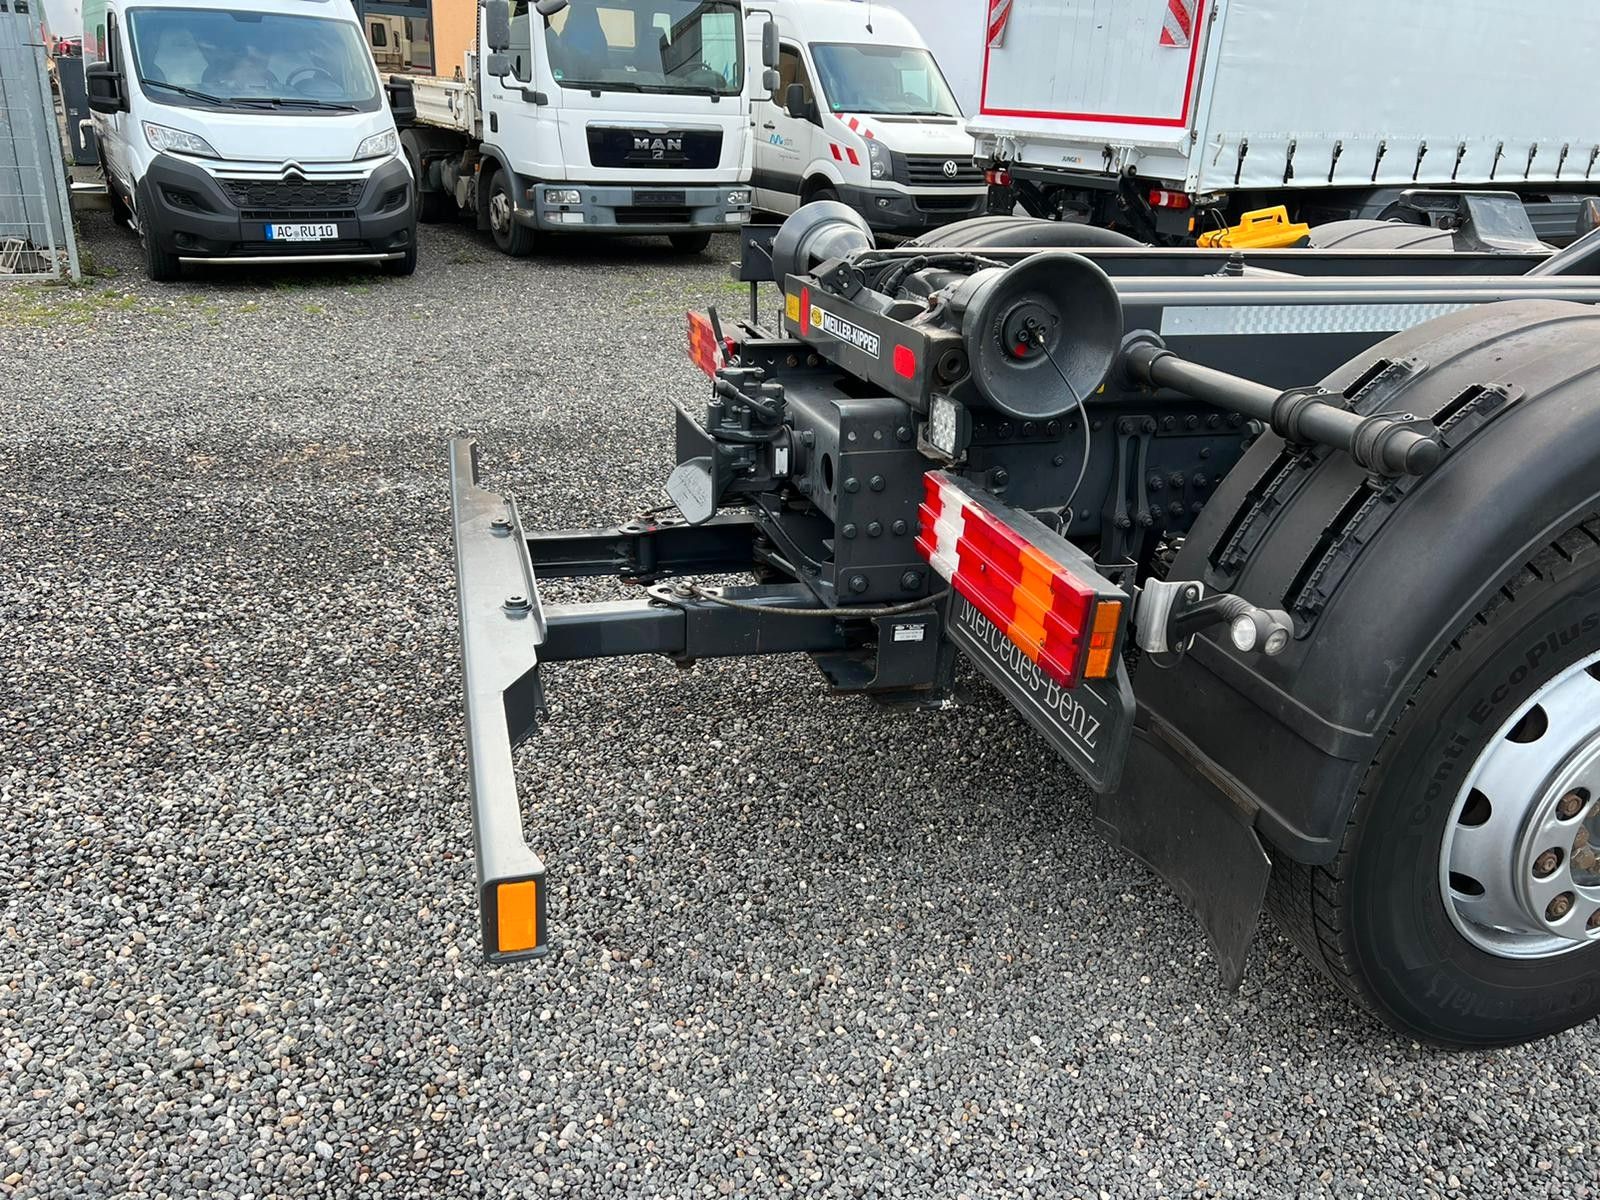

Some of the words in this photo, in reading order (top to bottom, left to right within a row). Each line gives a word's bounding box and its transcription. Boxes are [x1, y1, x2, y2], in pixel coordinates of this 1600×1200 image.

[633, 138, 682, 151] MAN
[277, 225, 293, 237] AC
[824, 313, 878, 355] MEILLER-KIPPER
[960, 598, 1101, 749] Mercedes-Benz
[1467, 612, 1600, 727] EcoPlus
